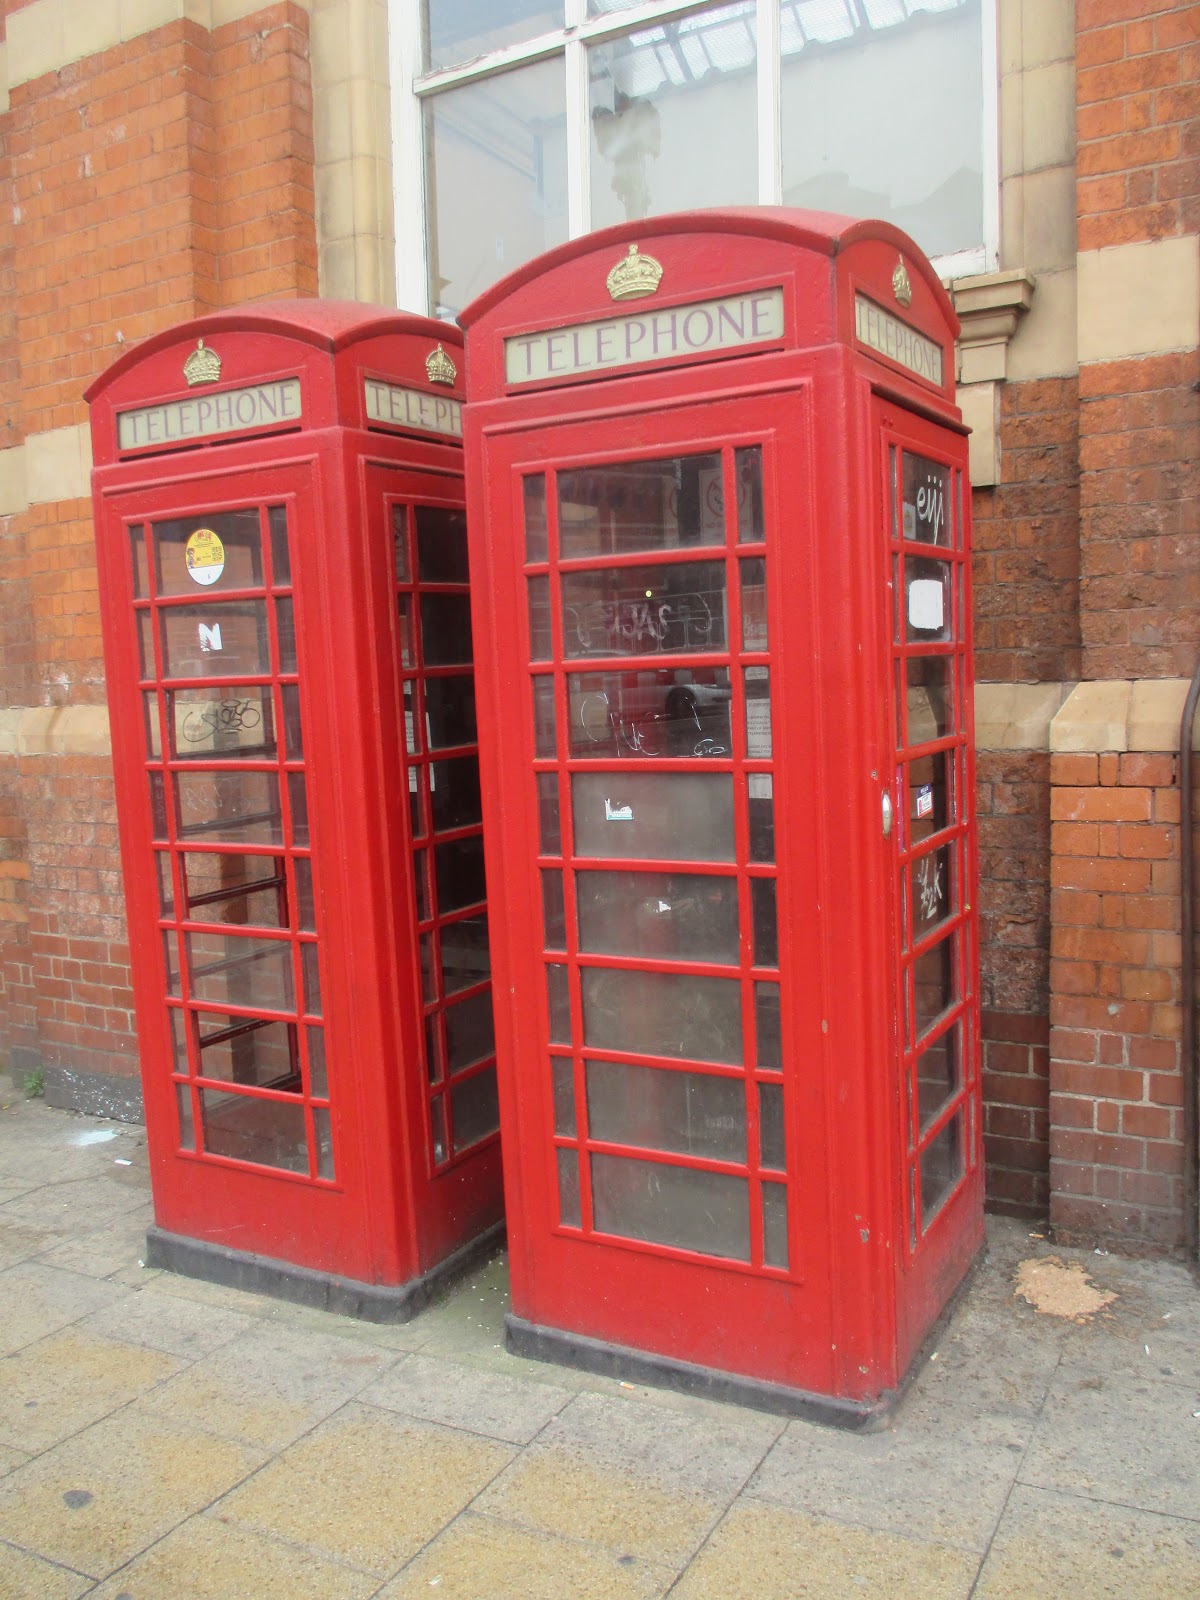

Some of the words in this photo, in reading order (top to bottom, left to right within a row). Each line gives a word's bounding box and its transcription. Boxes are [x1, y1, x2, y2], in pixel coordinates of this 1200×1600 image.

[518, 296, 774, 376] TELEPHONE
[856, 298, 941, 384] TELEPHONE
[126, 384, 297, 445] TELEPHONE
